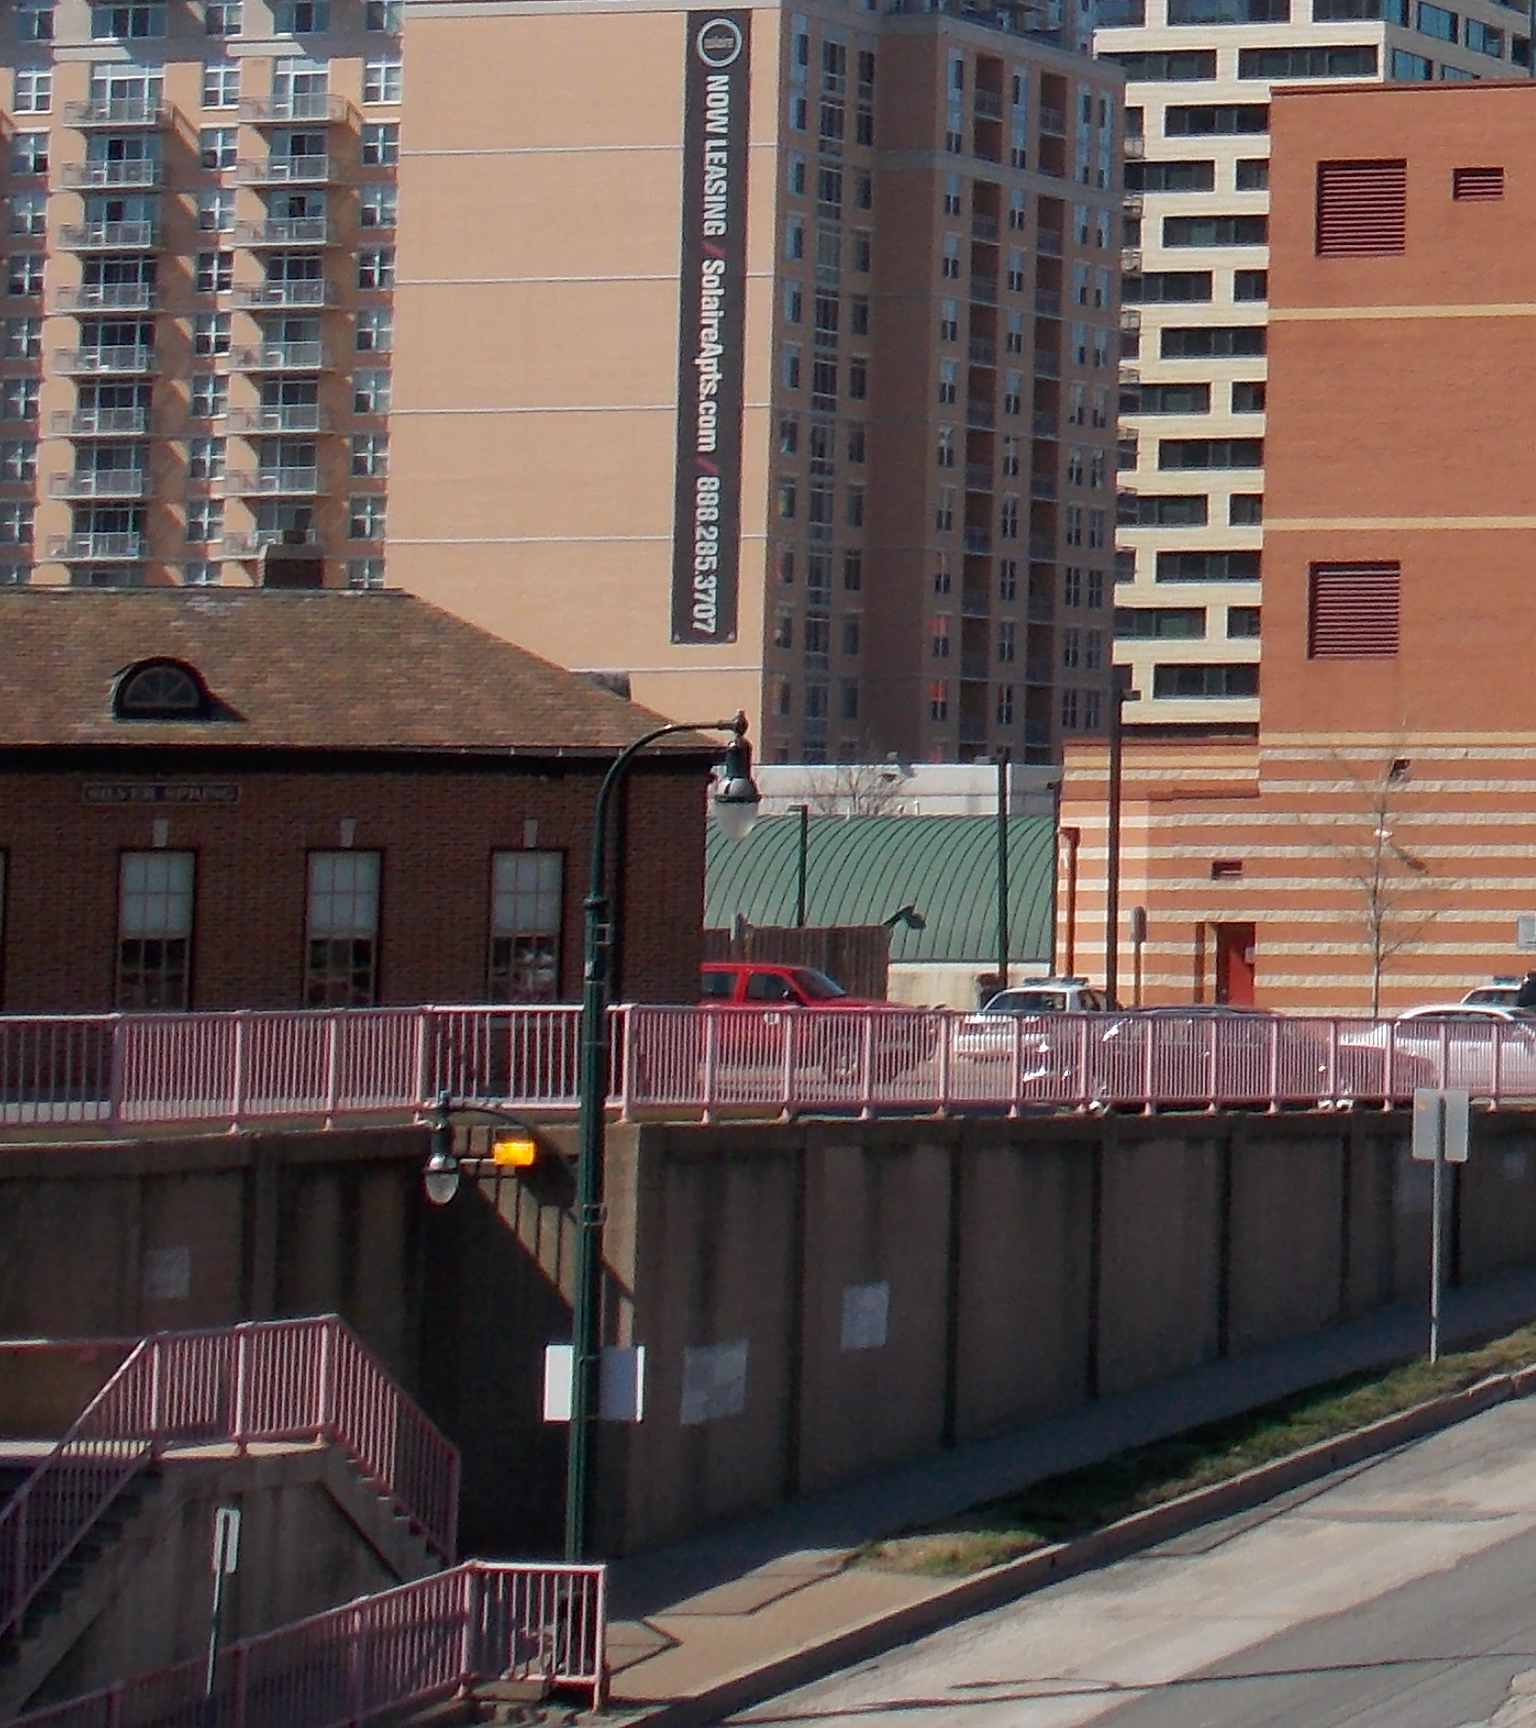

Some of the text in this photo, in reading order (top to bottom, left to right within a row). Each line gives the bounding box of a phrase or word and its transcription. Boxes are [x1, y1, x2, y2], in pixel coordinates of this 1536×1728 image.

[704, 75, 730, 134] NOW
[702, 138, 729, 236] LEASING
[694, 259, 727, 453] SolaireApts.com
[692, 476, 721, 633] 888.285.3707
